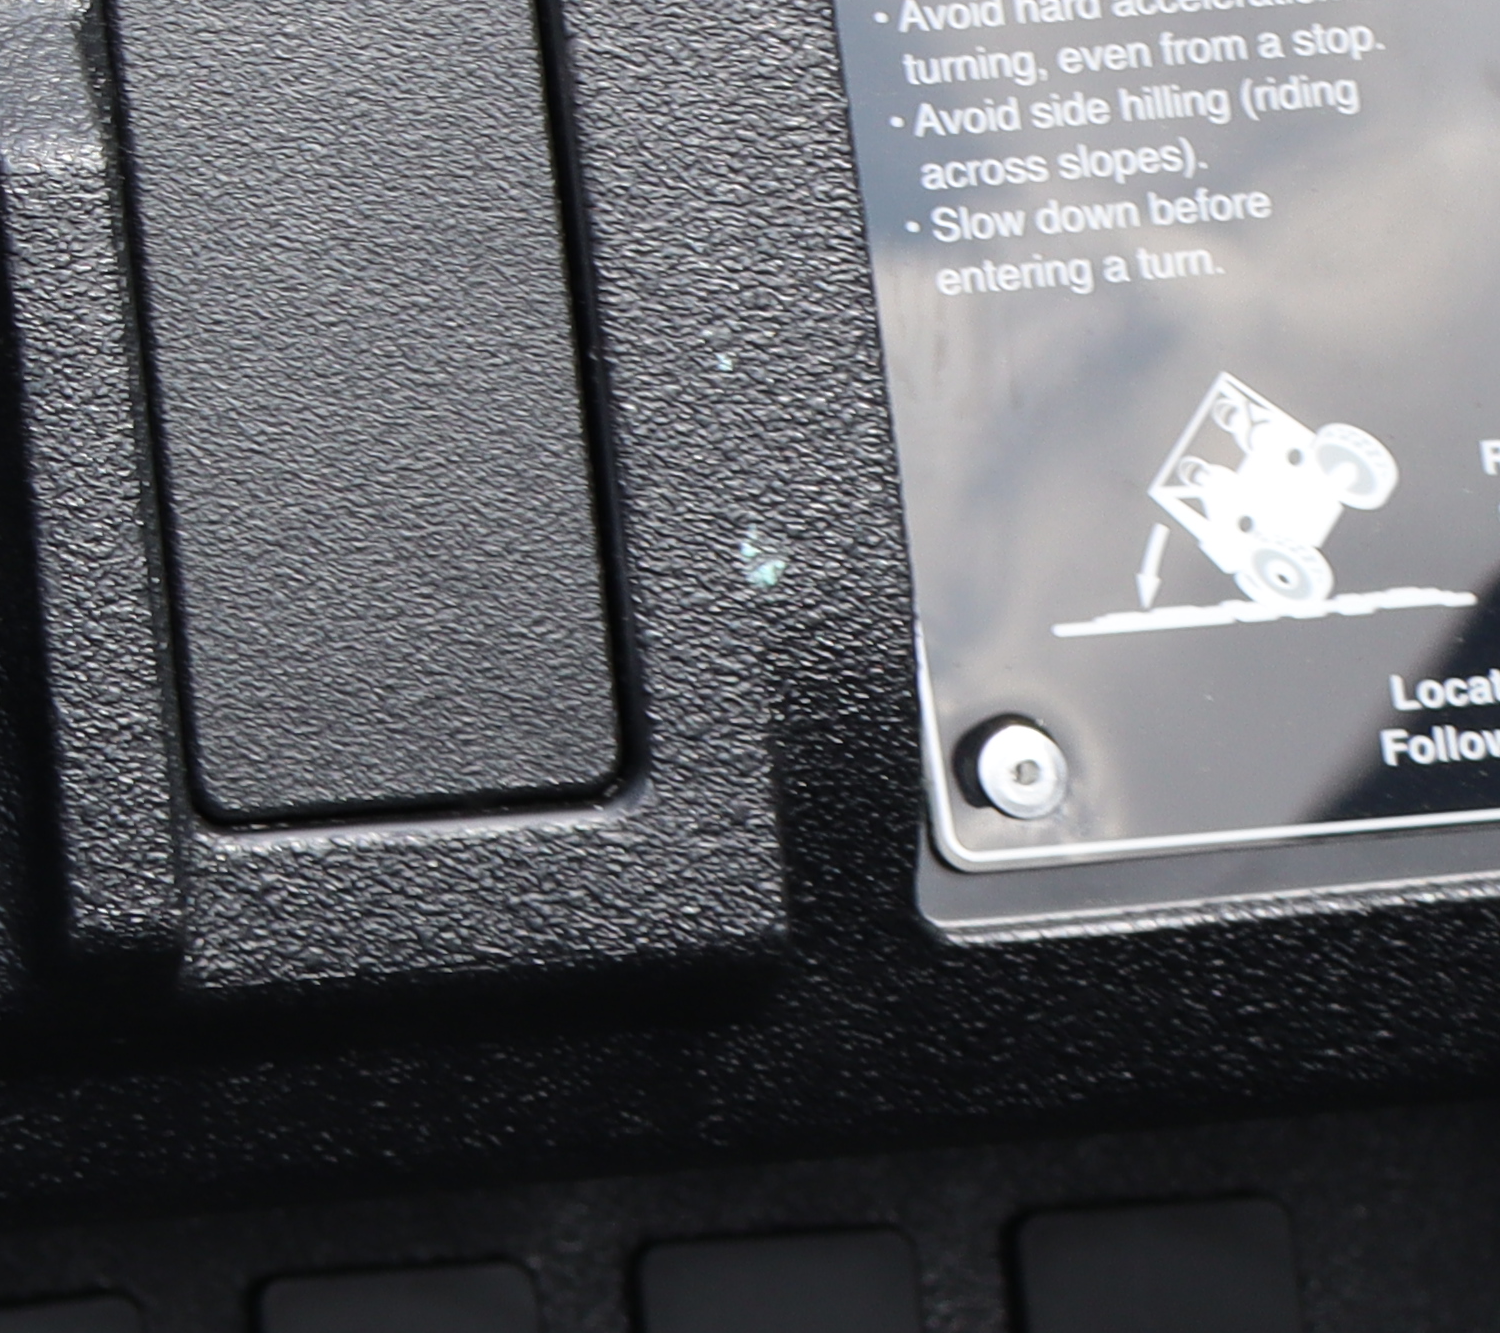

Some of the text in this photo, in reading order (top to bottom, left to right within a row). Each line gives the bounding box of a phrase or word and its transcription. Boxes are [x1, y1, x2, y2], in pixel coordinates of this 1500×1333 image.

[903, 24, 1385, 85] turning, even from a stop.
[915, 75, 1359, 137] Avoid side hilling (riding
[922, 138, 1207, 189] across slopes).
[933, 189, 1270, 241] Slow down before
[936, 248, 1224, 295] entering a turn.
